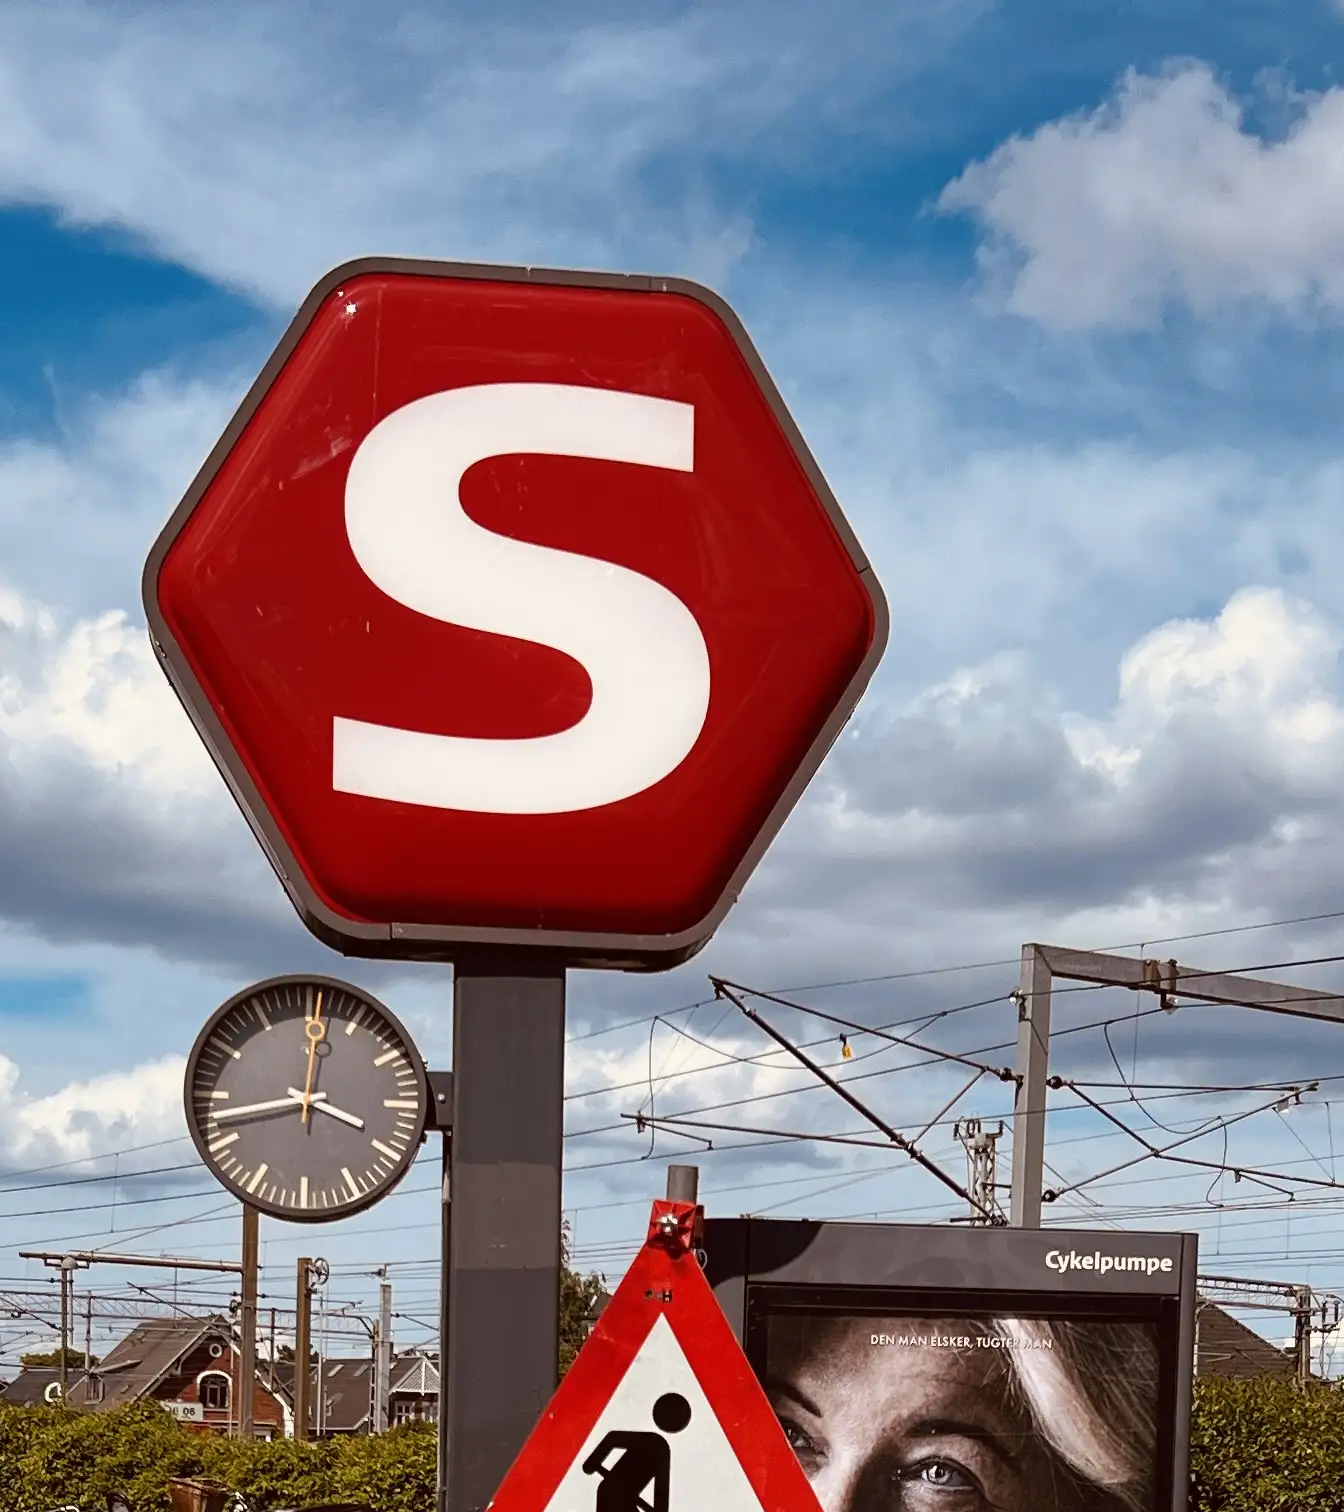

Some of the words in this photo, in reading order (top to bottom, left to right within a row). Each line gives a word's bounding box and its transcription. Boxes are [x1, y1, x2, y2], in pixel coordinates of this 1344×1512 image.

[332, 382, 712, 815] S
[1045, 1250, 1174, 1276] Cykelpumpe
[870, 1334, 896, 1346] DEN
[898, 1335, 928, 1347] MAN
[930, 1336, 974, 1349] ELSKER,
[976, 1337, 1019, 1349] TUGTER
